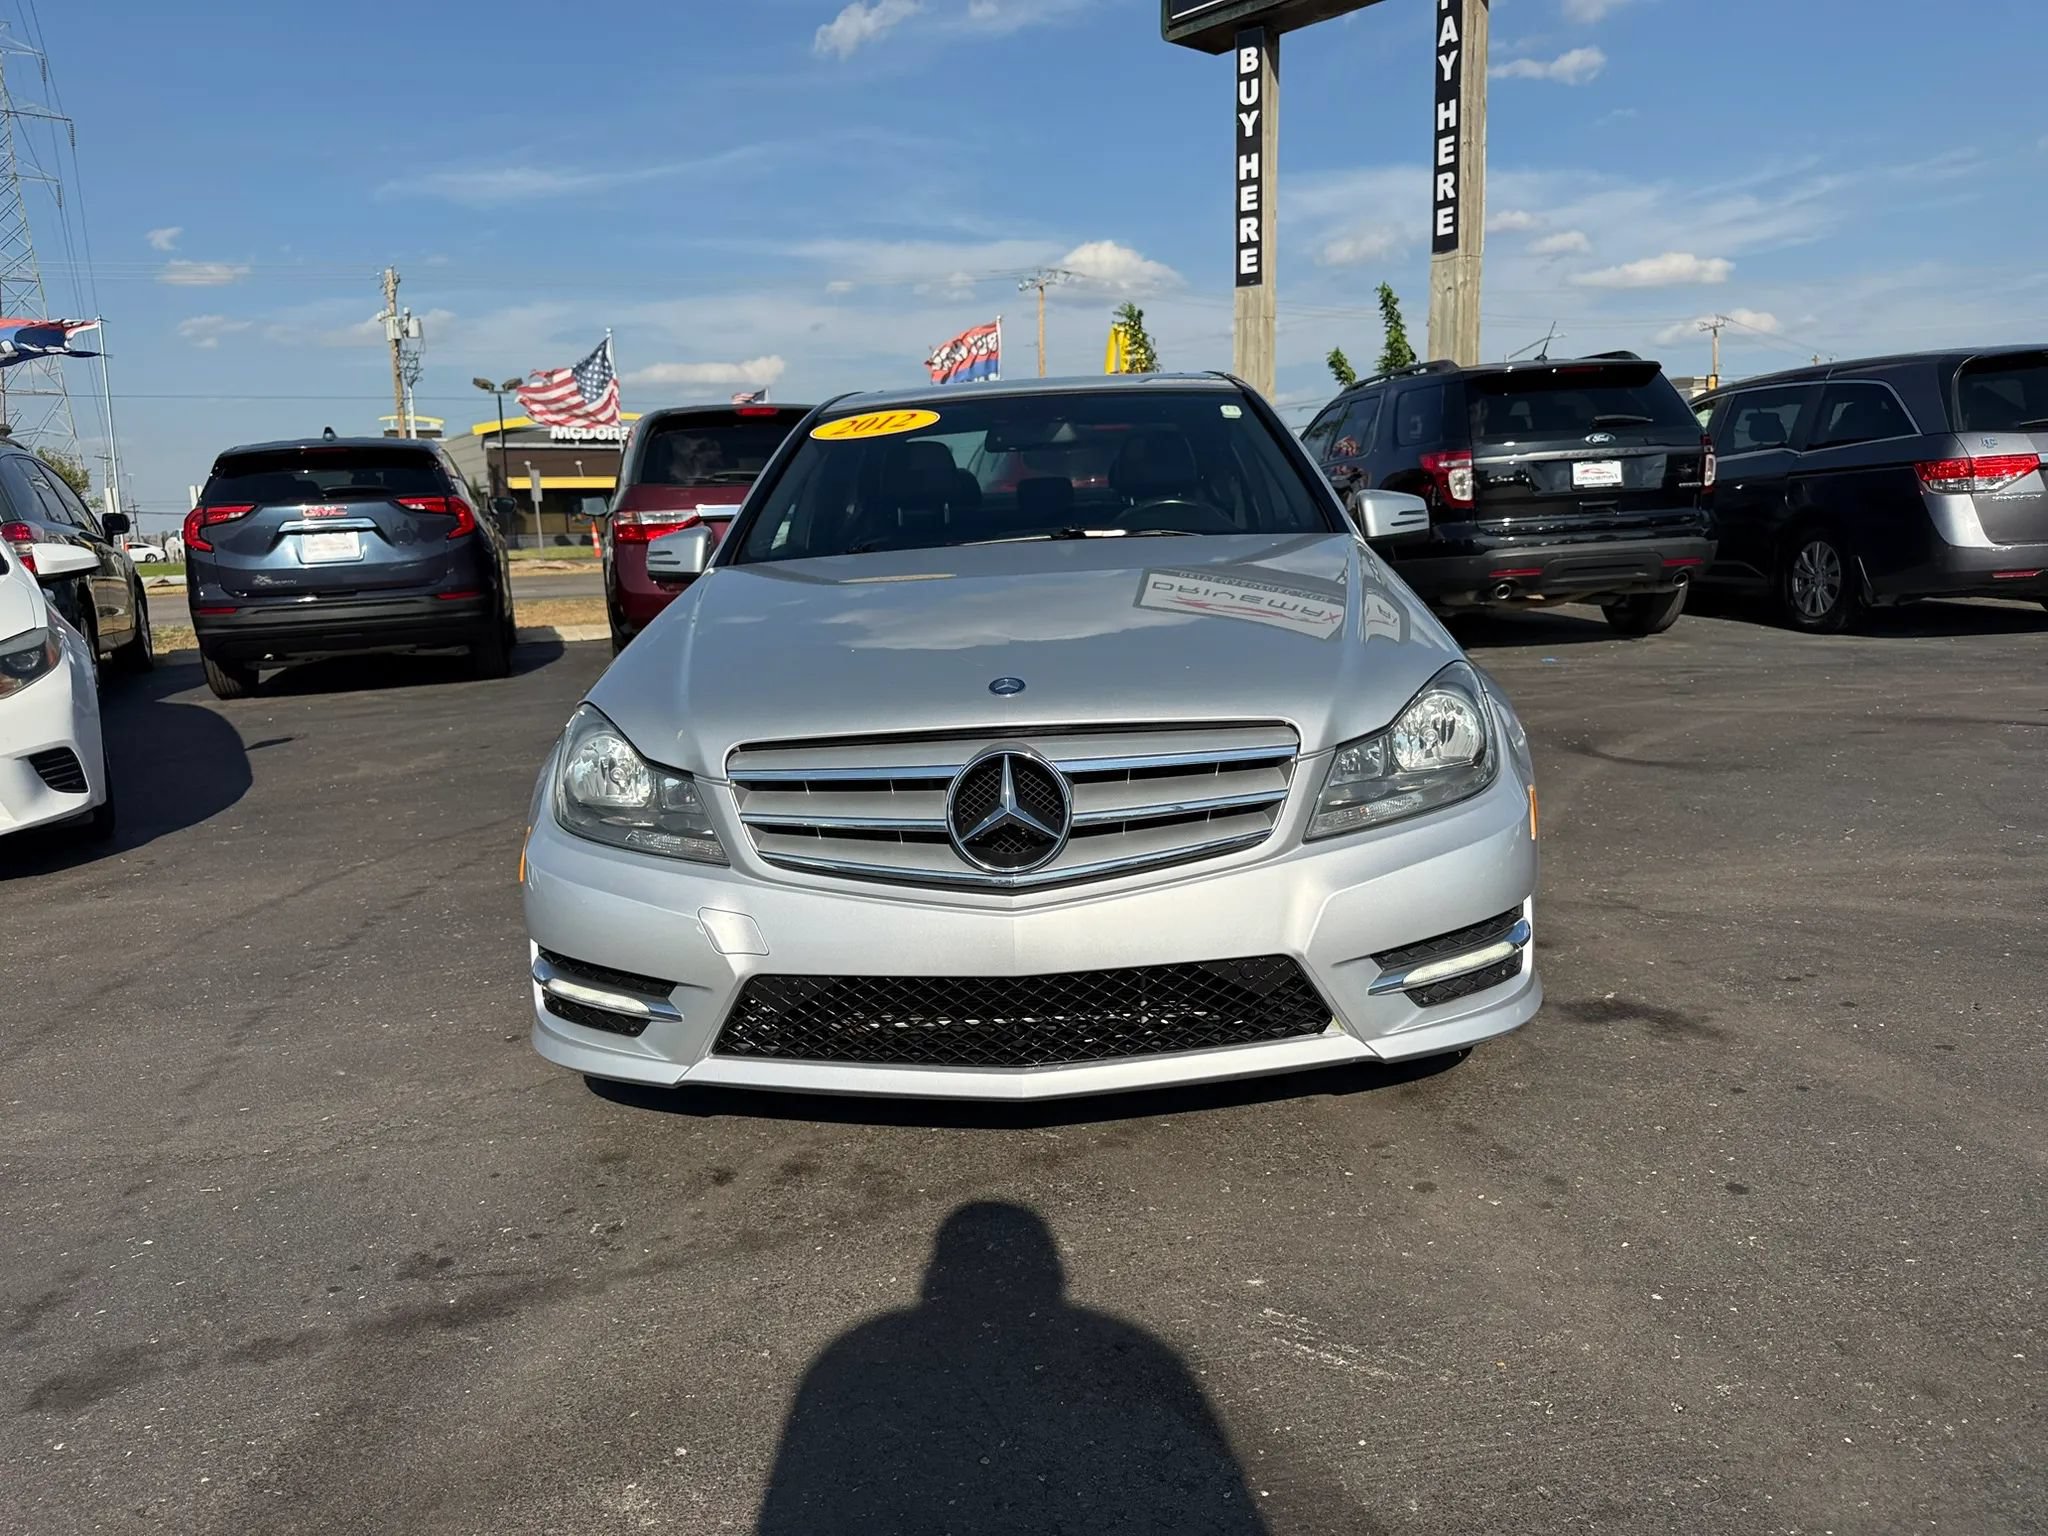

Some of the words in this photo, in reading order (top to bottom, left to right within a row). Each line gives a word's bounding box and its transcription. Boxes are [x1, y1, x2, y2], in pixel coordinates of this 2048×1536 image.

[1238, 46, 1260, 138] BUY
[1238, 152, 1260, 275] HERE
[1436, 98, 1457, 237] HERE
[829, 412, 918, 437] 2012
[302, 505, 348, 518] GMC
